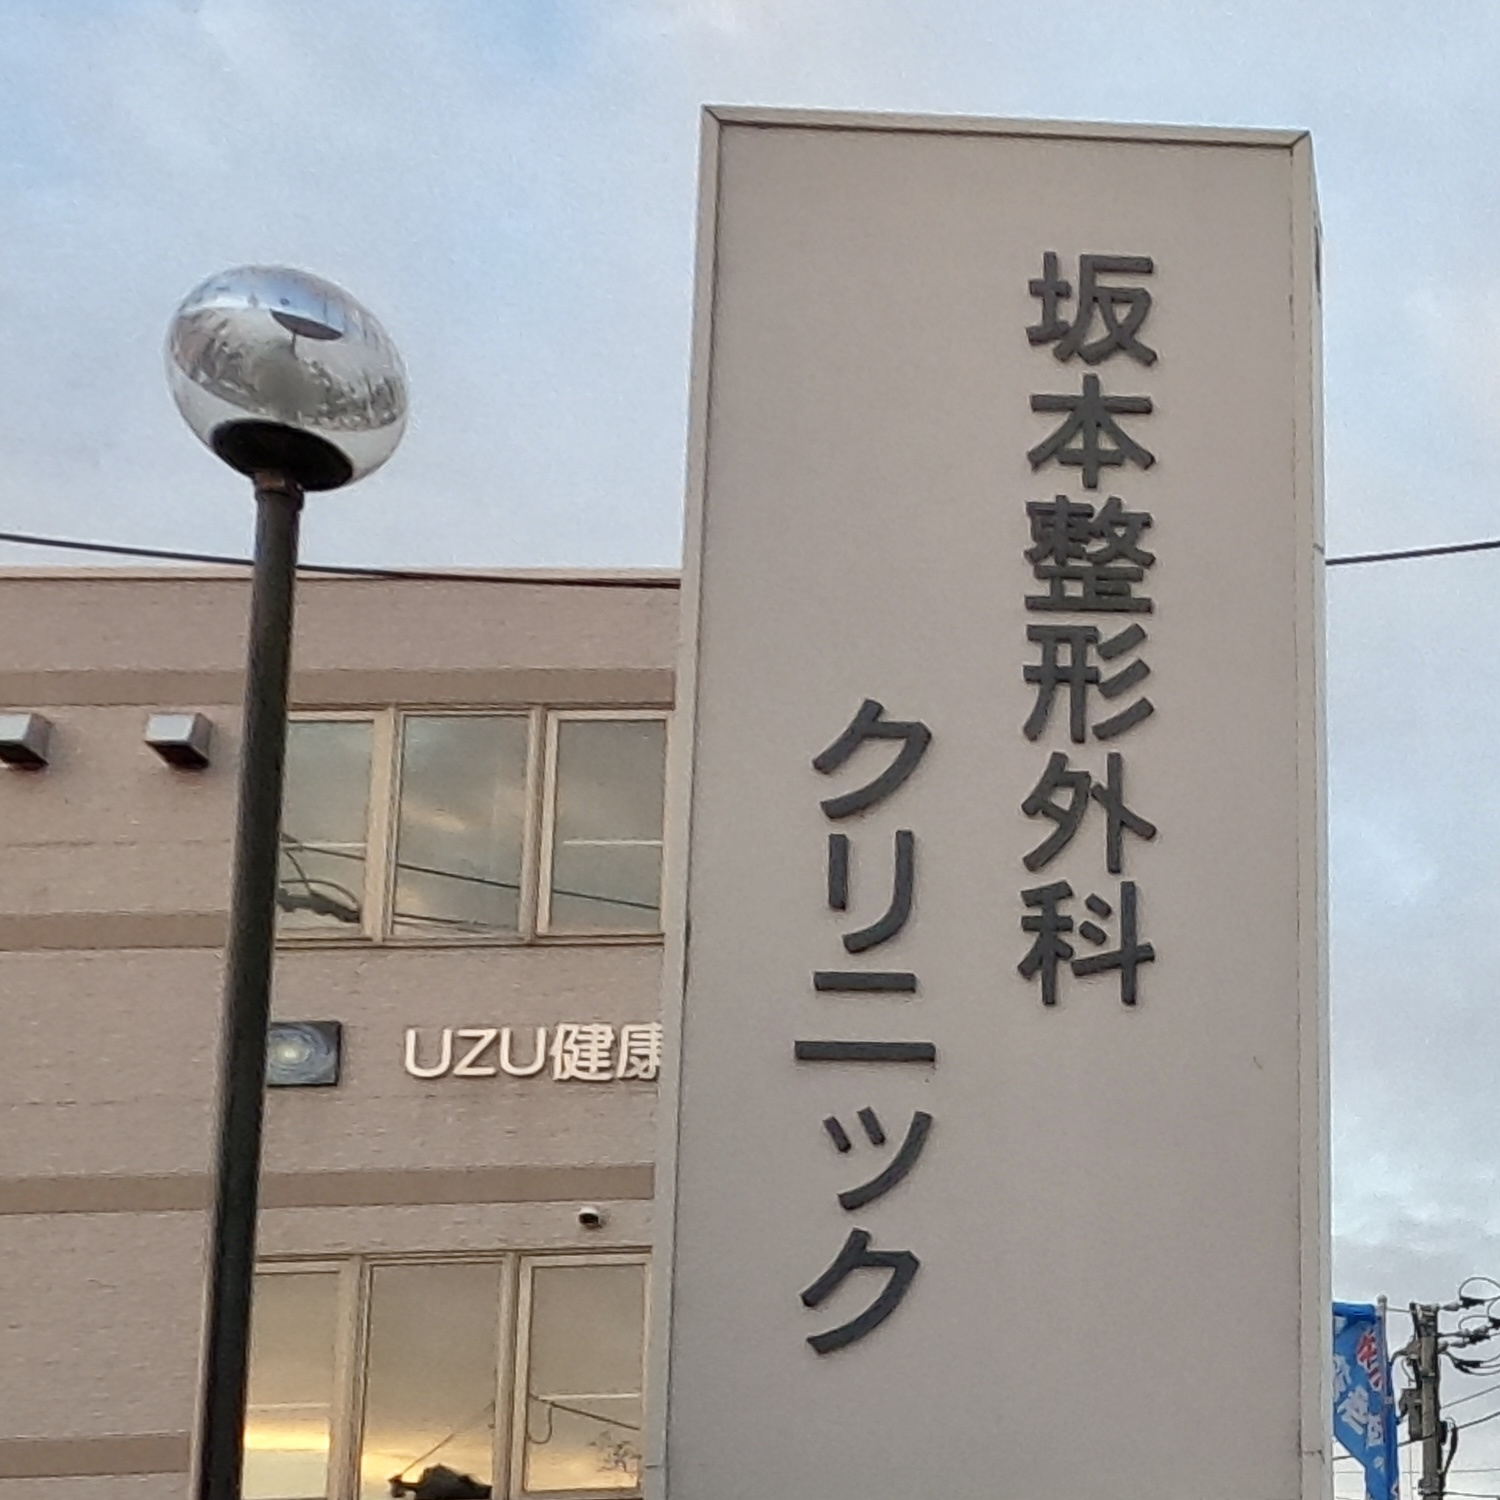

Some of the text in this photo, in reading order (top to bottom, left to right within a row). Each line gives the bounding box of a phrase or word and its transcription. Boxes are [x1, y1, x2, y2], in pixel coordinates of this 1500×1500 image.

[1018, 251, 1157, 1006] 坂本整形外科
[404, 1021, 663, 1081] UZU健康
[794, 698, 937, 1354] クリニック
